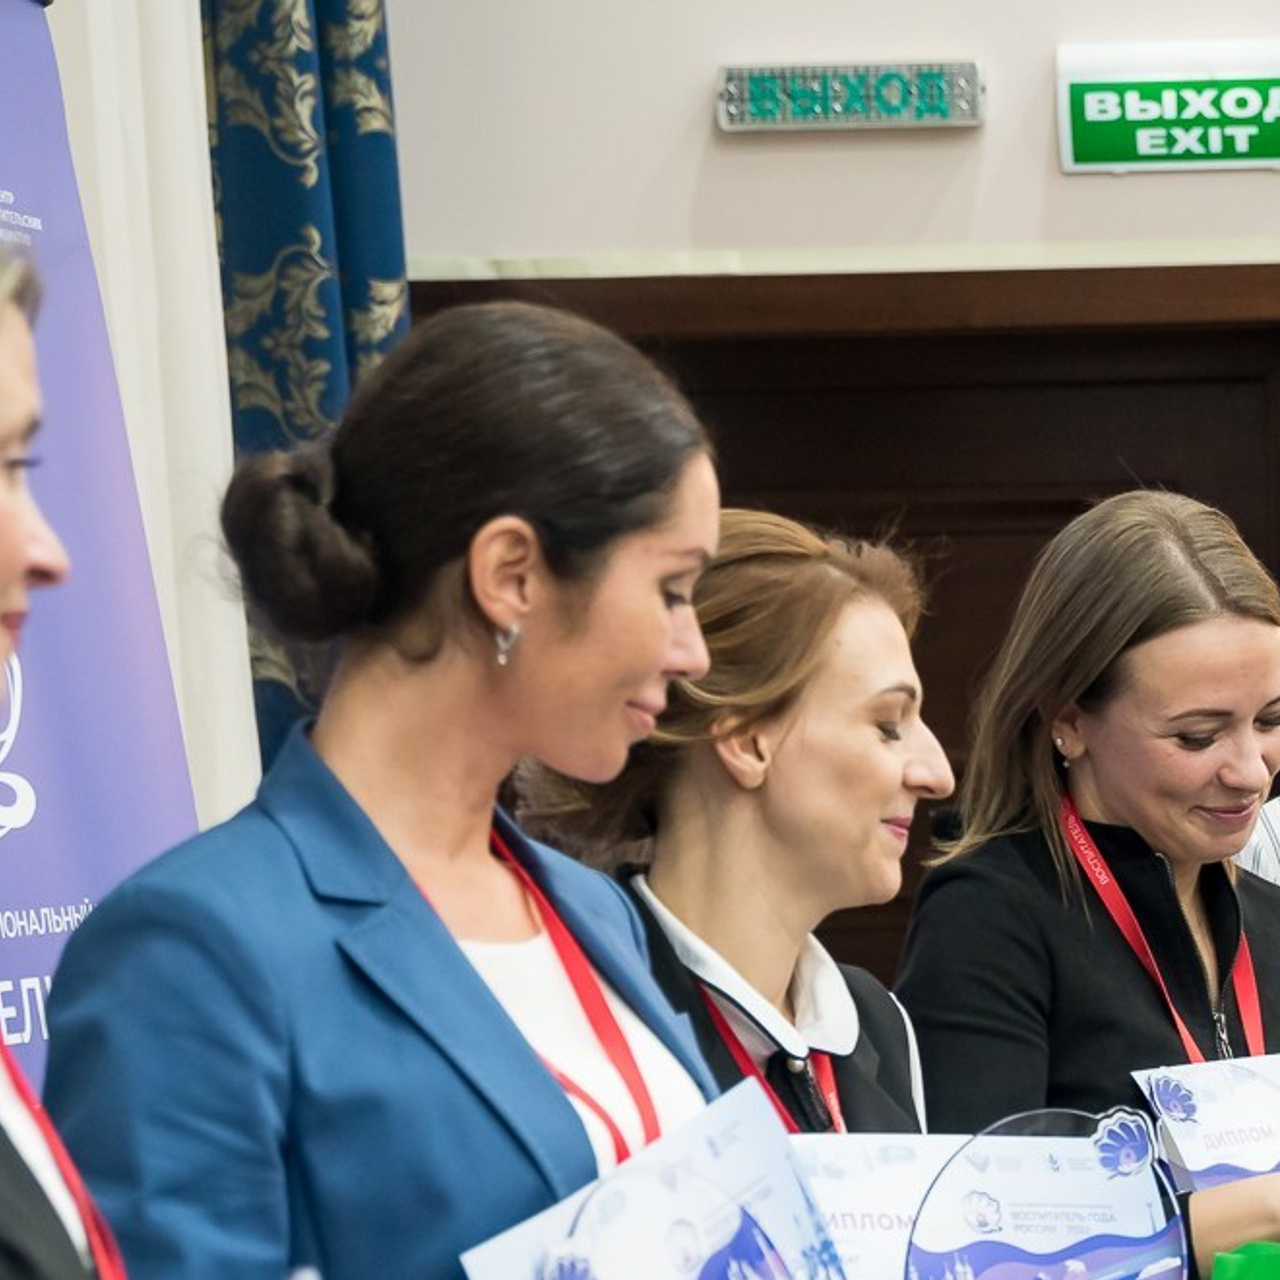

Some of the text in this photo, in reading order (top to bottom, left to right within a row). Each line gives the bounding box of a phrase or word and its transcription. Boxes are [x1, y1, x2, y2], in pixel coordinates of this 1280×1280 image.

[748, 71, 949, 118] ВЫХОД
[1136, 125, 1258, 155] EXIT
[0, 974, 52, 1046] ЕЛ
[823, 1212, 913, 1231] ИПЛОМ
